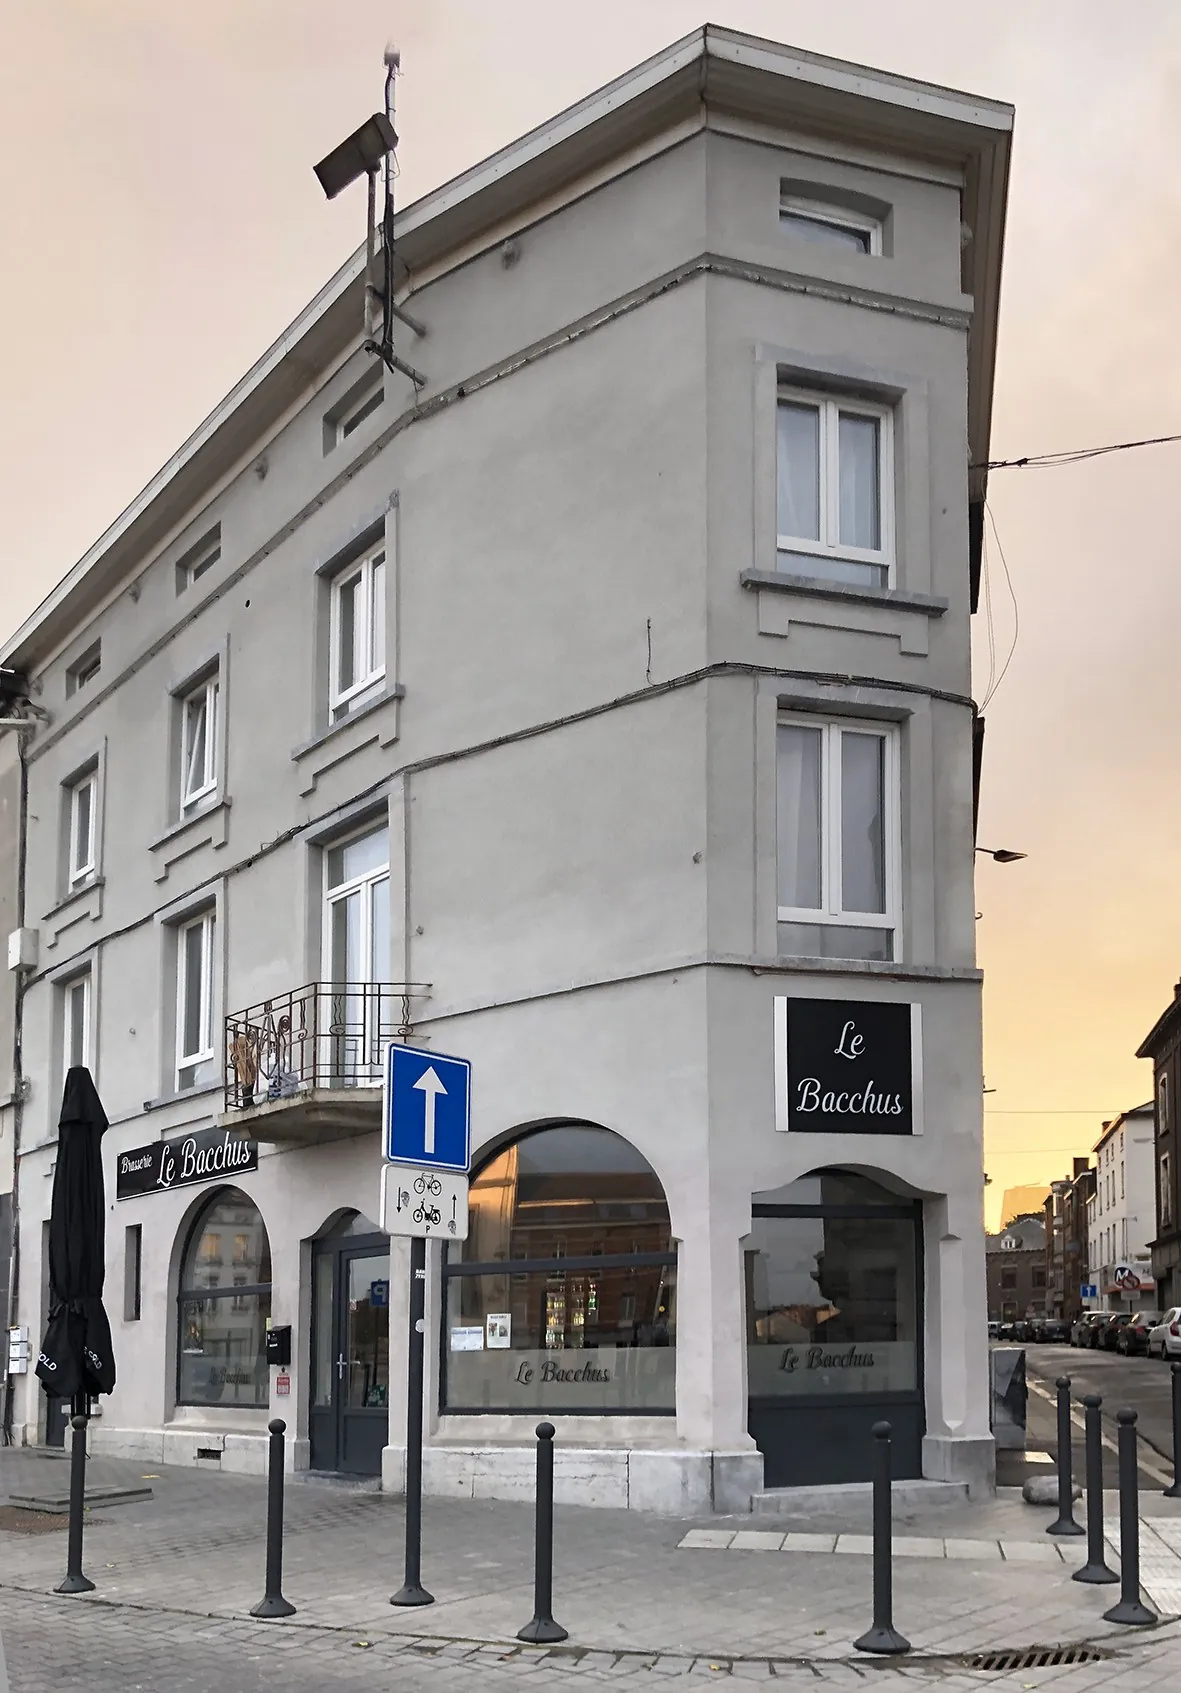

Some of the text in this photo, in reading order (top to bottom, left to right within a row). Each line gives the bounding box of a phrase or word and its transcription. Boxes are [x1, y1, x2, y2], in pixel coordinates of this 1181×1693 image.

[833, 1020, 866, 1060] Le
[796, 1077, 904, 1115] Bacchus
[121, 1154, 153, 1174] Brasserie
[156, 1131, 251, 1188] Le Bacchus
[425, 1225, 431, 1234] P
[38, 1350, 57, 1371] OLD
[778, 1344, 875, 1373] Le Bacchus
[514, 1360, 609, 1386] Le Bacchus
